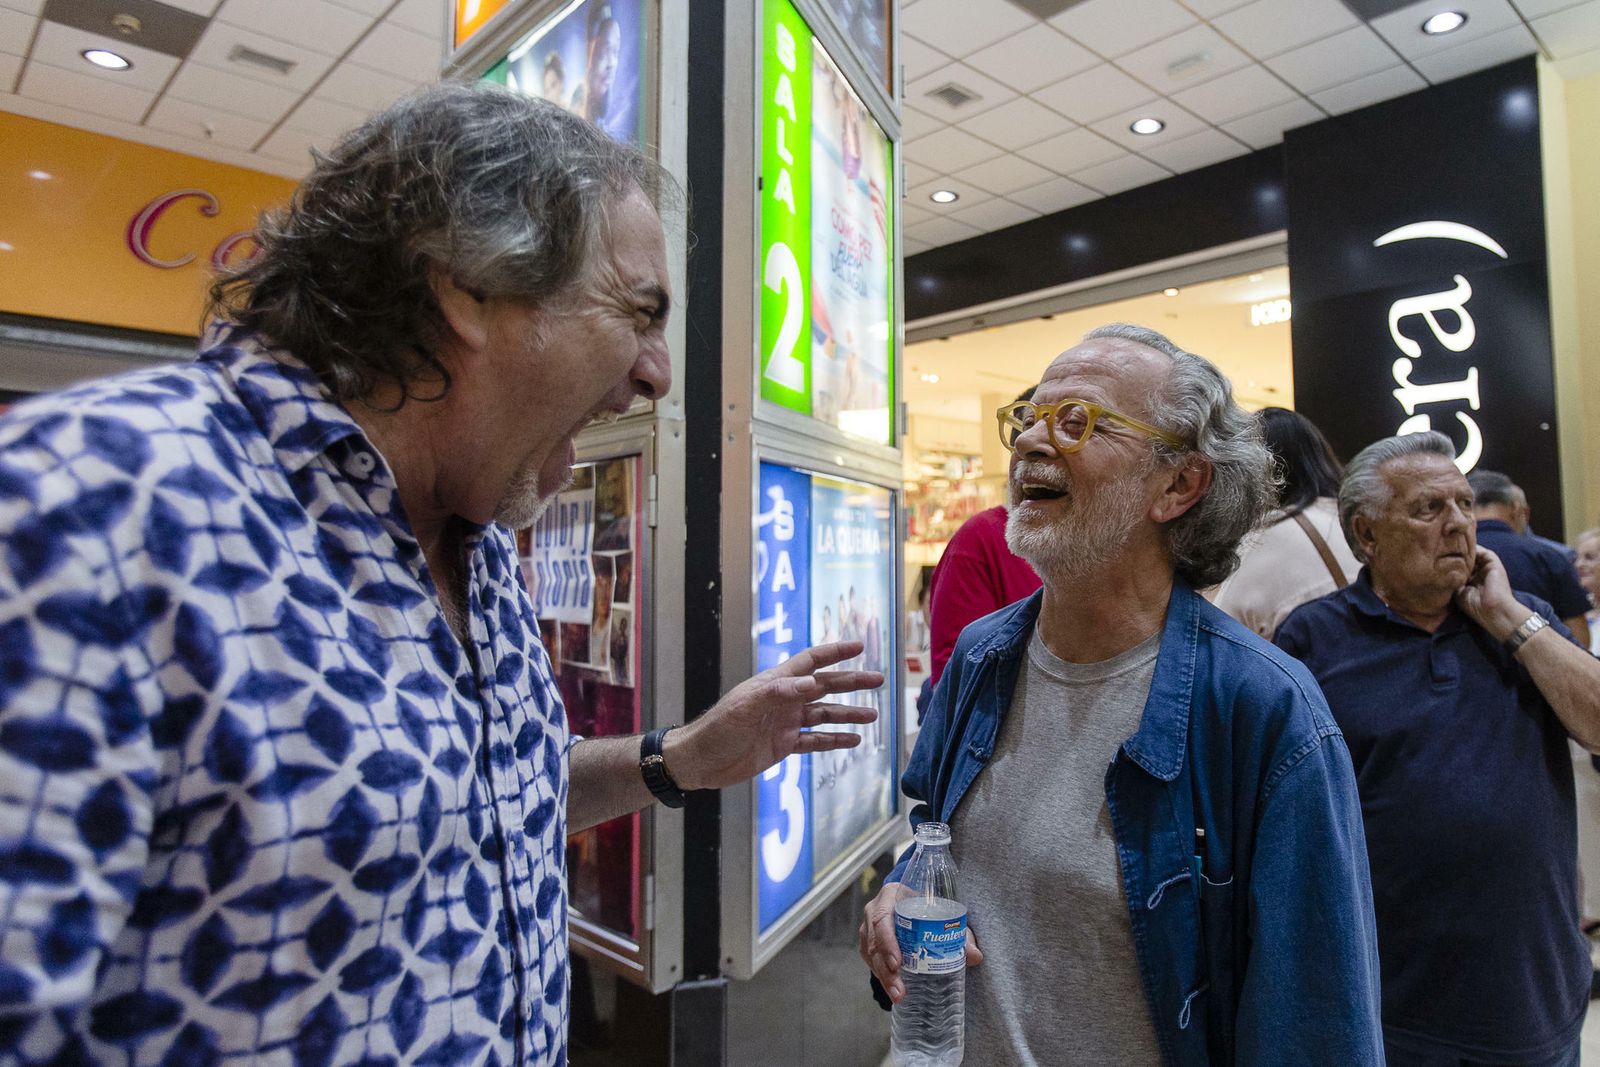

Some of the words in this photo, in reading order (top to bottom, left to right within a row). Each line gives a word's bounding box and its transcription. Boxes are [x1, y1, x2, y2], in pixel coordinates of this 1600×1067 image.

[773, 22, 797, 215] SALA
[764, 241, 805, 394] 2
[535, 550, 591, 617] gloria
[761, 753, 806, 883] 3
